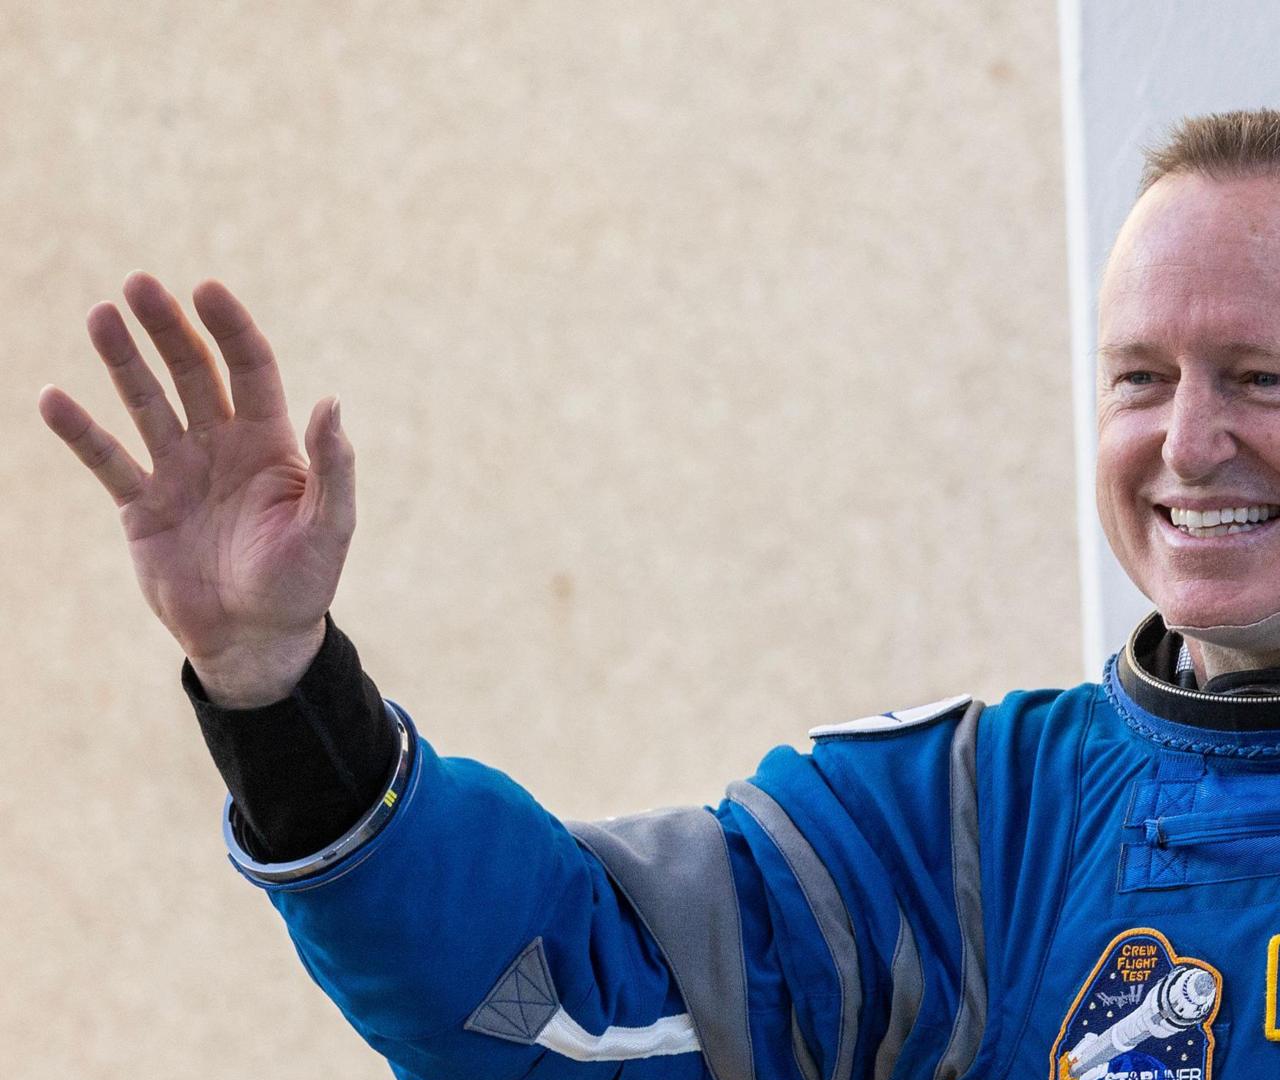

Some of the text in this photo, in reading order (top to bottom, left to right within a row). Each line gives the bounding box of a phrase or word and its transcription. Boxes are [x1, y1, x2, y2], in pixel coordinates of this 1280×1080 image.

[1122, 944, 1157, 956] CREW
[1117, 957, 1159, 970] FLIGHT
[1121, 970, 1151, 982] TEST
